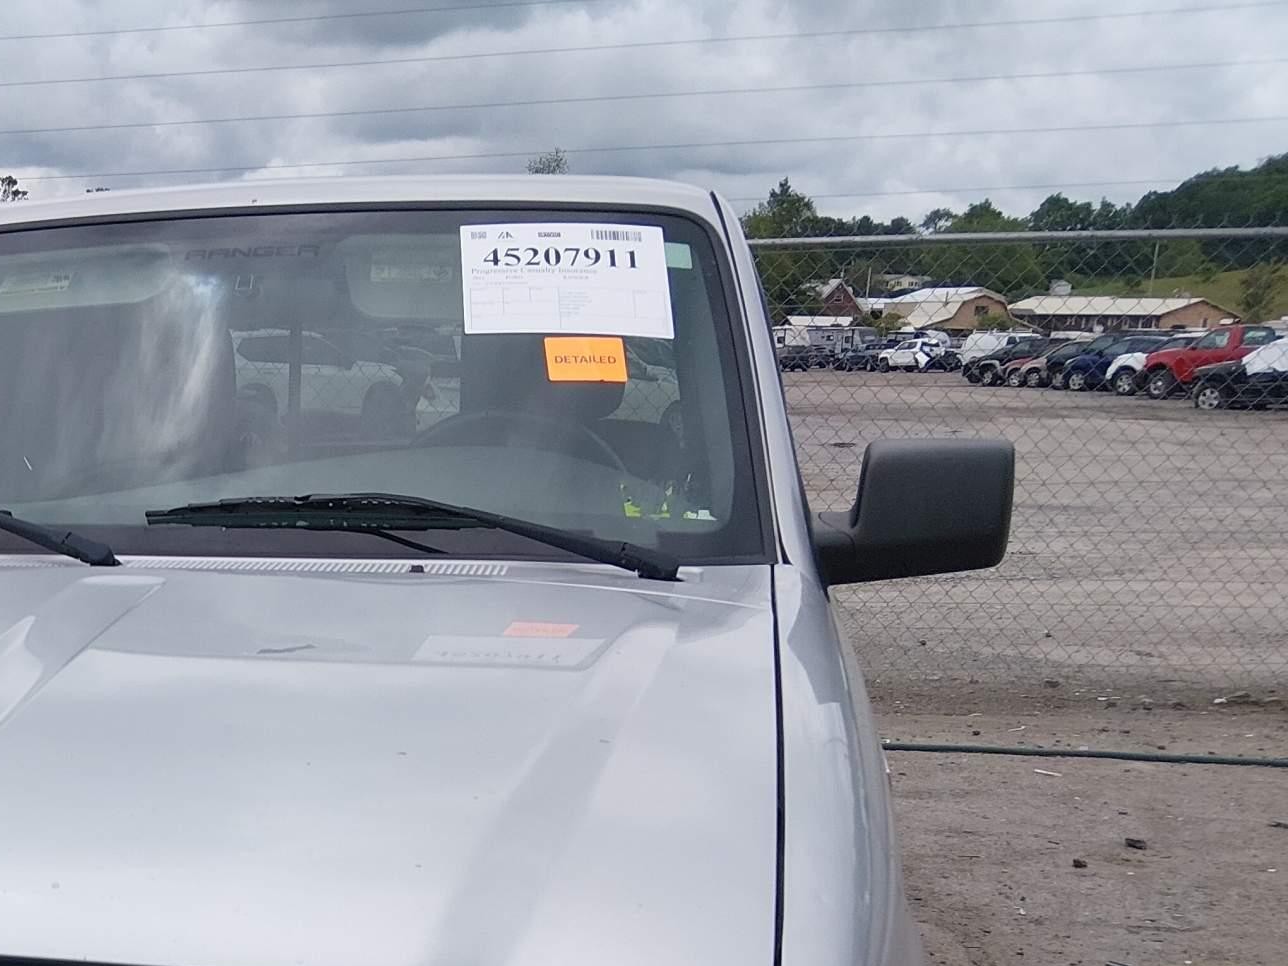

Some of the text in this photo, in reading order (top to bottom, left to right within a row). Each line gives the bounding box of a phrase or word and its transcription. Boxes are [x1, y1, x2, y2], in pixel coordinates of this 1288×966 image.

[184, 244, 321, 260] RANGER
[483, 247, 639, 269] 45207911
[554, 354, 617, 366] DETAILED
